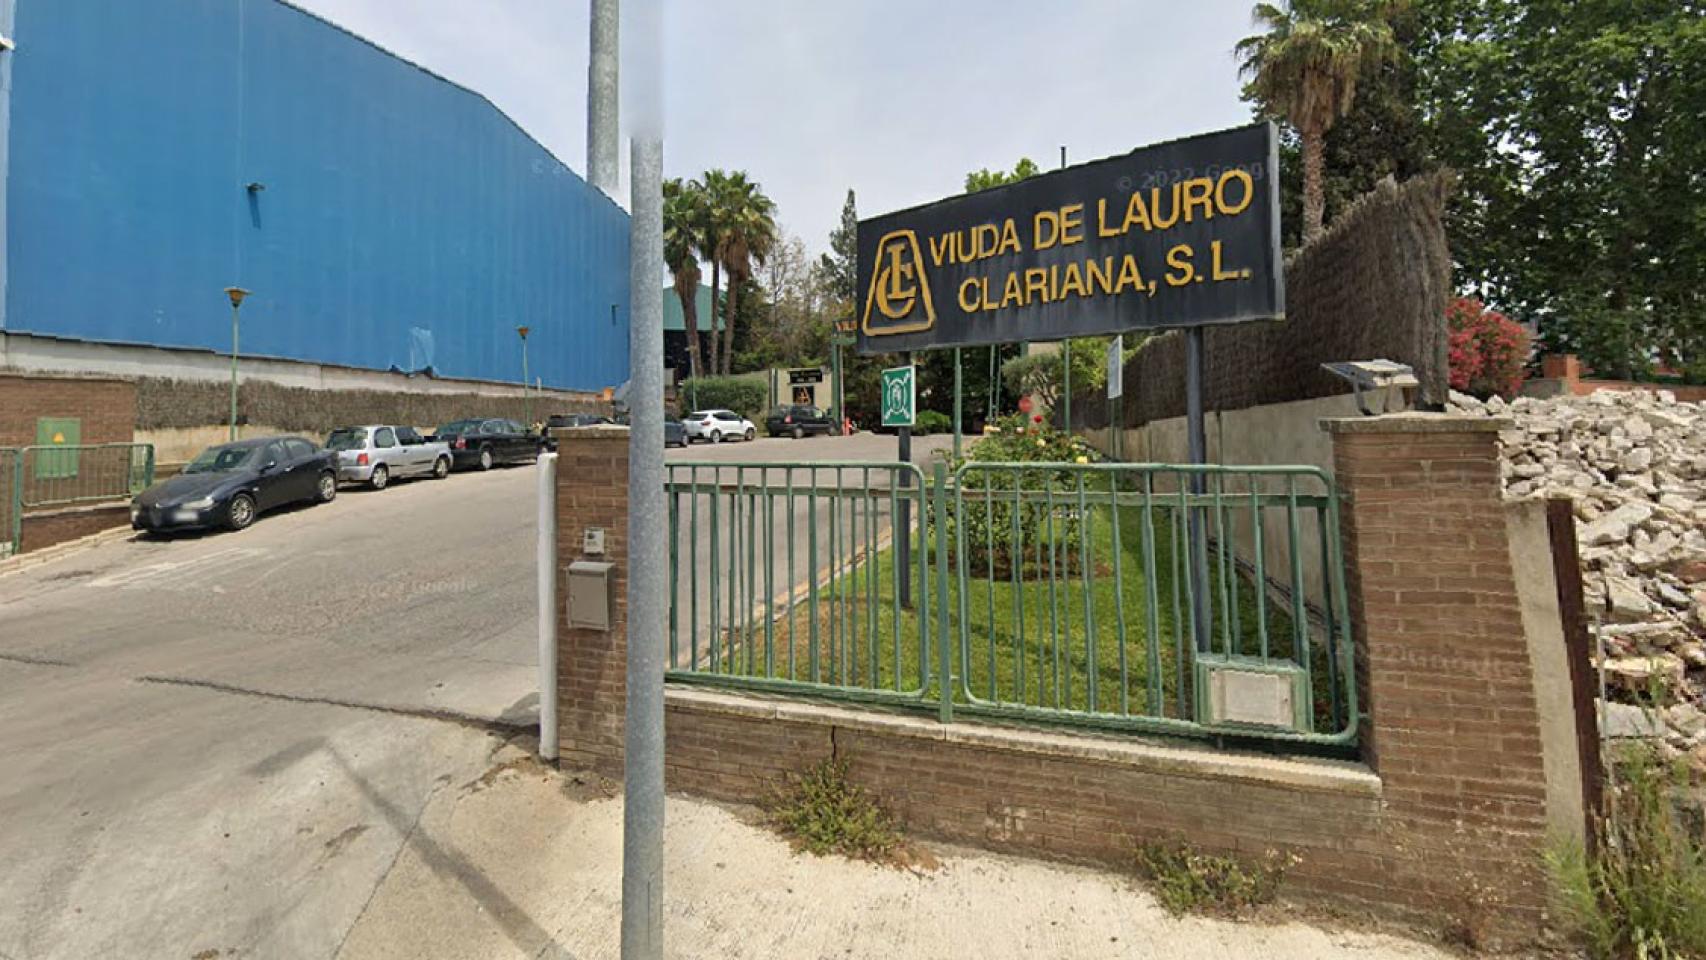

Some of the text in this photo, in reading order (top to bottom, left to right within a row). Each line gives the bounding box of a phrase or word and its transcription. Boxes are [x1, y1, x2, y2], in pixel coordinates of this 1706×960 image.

[928, 168, 1254, 267] VIUDA DE LAURO
[958, 254, 1157, 313] CLARIANA,
